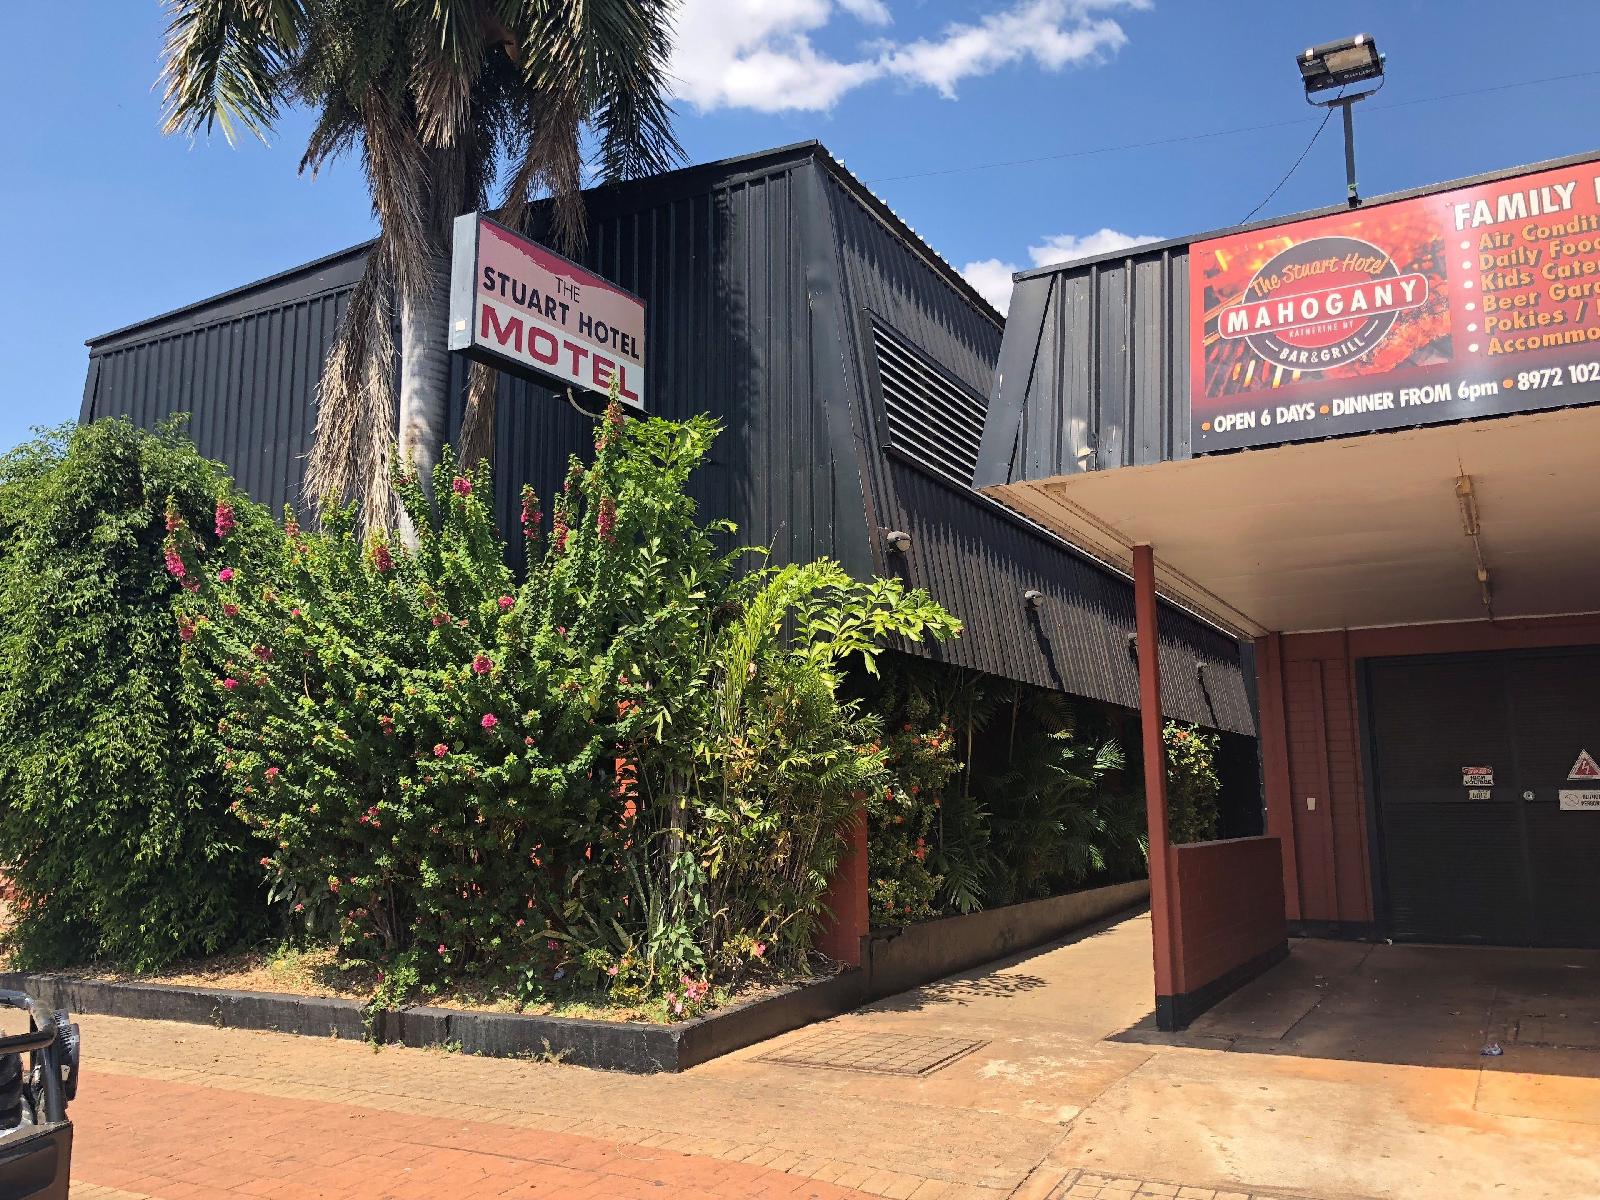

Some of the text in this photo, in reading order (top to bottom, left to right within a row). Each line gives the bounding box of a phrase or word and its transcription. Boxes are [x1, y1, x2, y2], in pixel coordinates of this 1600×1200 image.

[1454, 181, 1576, 231] FAMILY
[1479, 232, 1511, 250] Air
[1479, 247, 1539, 271] Daily
[555, 276, 580, 303] THE
[1250, 252, 1390, 297] The Stuart Hotel
[1480, 260, 1600, 291] Kids Cate
[482, 266, 639, 360] STUART HOTEL
[1228, 279, 1417, 333] MAHOGANY
[1483, 292, 1538, 313] Beer
[1484, 308, 1564, 334] Pokies
[481, 303, 639, 402] MOTEL
[1214, 411, 1256, 433] OPEN
[1260, 409, 1271, 426] 6
[1276, 403, 1315, 424] DAYS
[1332, 392, 1394, 416] DINNER
[1400, 383, 1452, 408] FROM
[1458, 380, 1499, 402] 6pm
[1517, 368, 1563, 391] 8972
